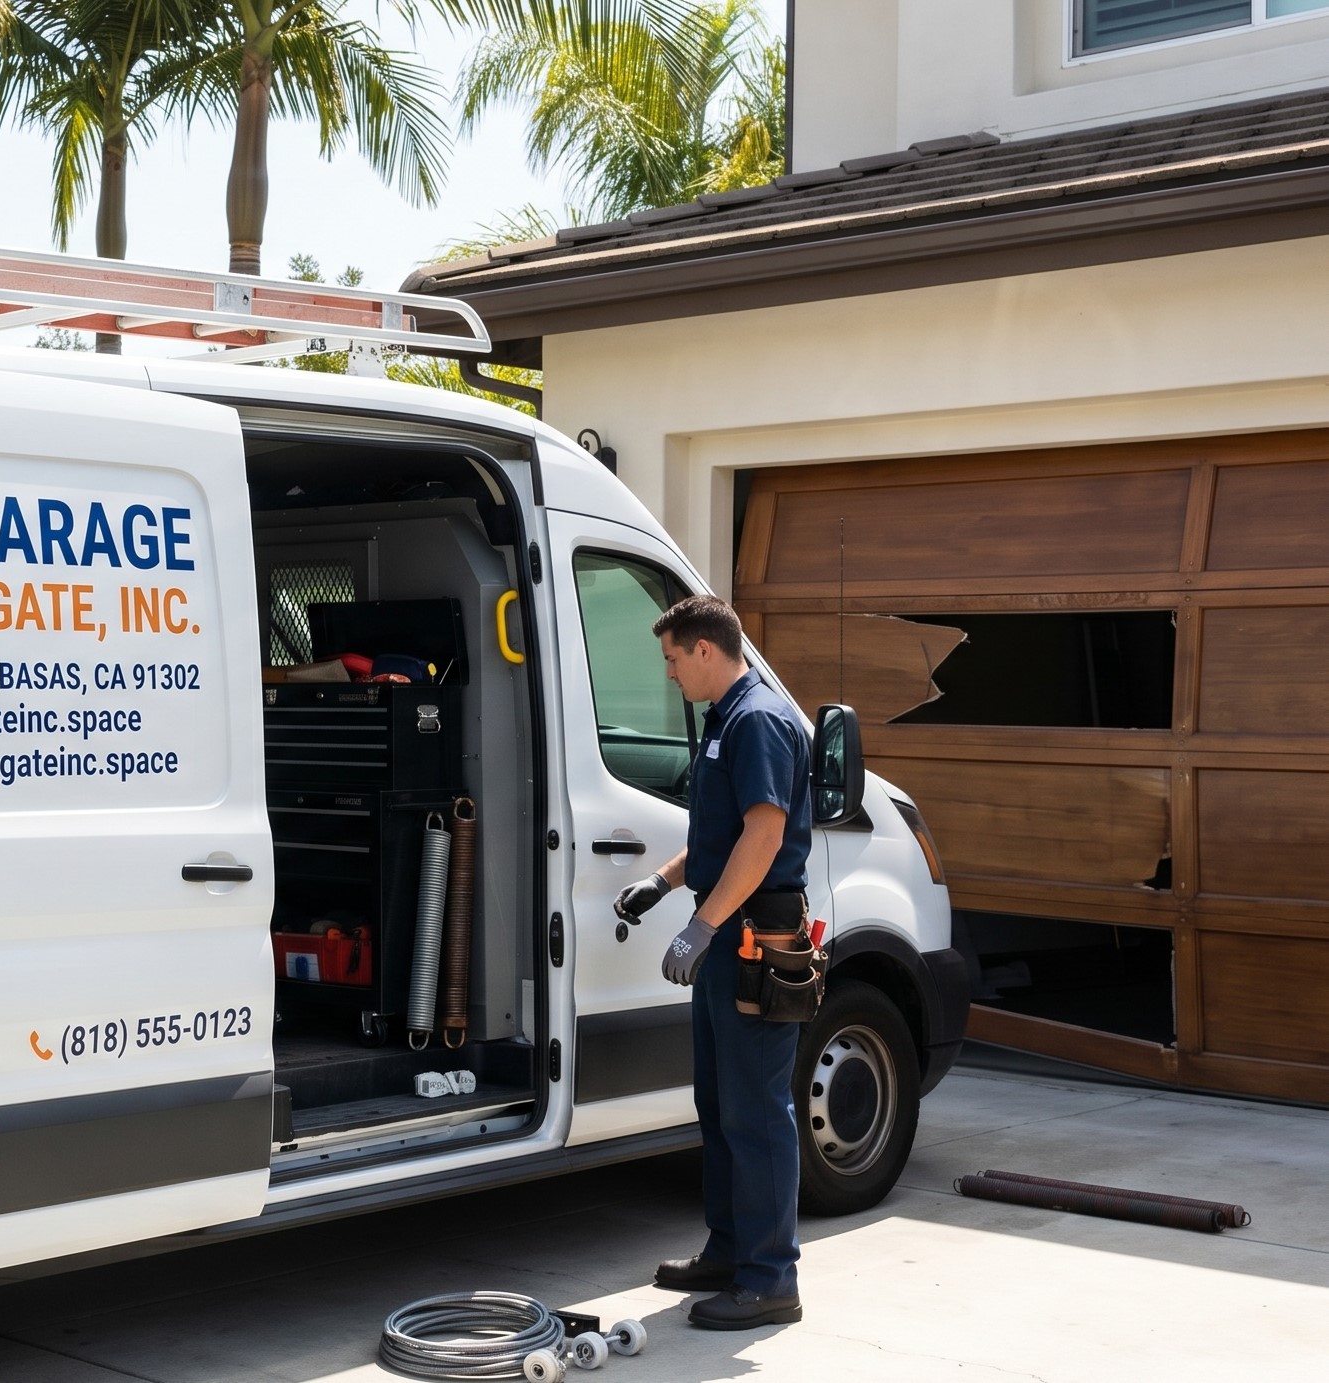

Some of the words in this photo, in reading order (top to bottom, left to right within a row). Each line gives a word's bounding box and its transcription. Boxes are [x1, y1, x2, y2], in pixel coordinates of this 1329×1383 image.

[120, 586, 201, 634] INC.
[94, 663, 127, 690] CA
[132, 663, 200, 690] 91302
[61, 1019, 128, 1064] (818)
[136, 1006, 252, 1047] 555-0123
